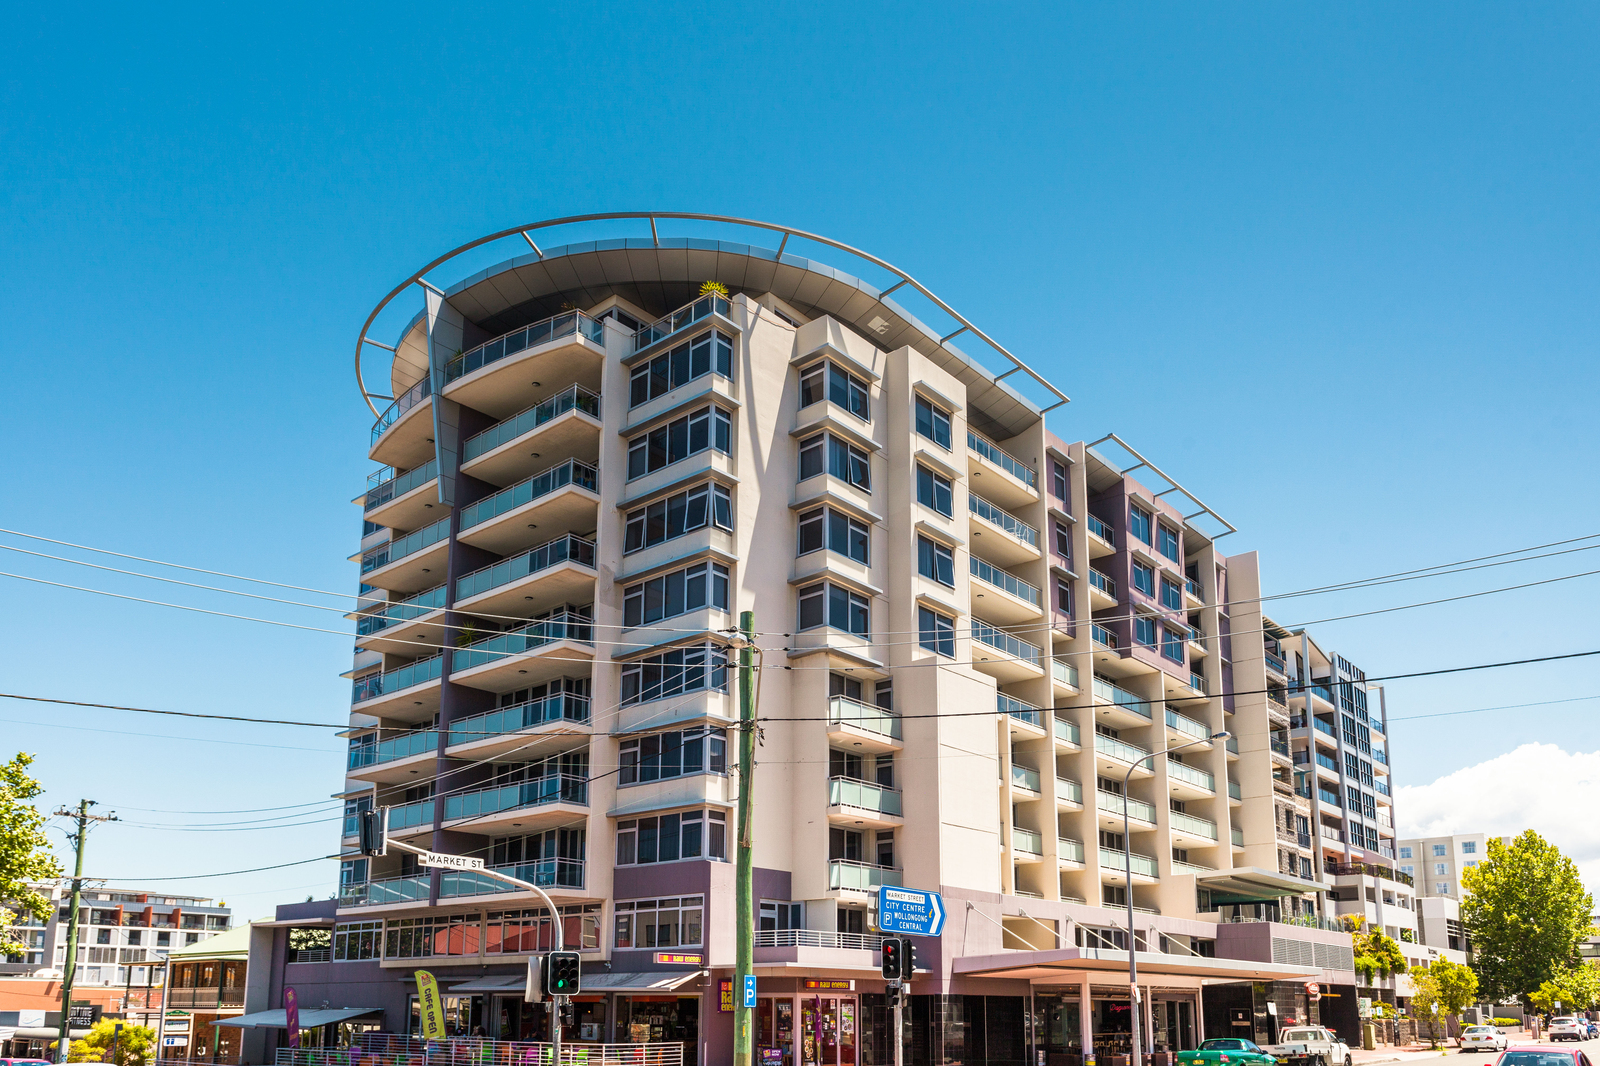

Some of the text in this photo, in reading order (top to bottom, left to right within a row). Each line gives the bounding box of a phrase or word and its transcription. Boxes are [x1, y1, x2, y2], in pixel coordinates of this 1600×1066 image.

[428, 855, 482, 869] MARKET ST
[886, 891, 924, 903] MARKET STREET
[885, 901, 926, 914] CITY CENTRE
[893, 911, 928, 923] WOLLONGONG
[898, 921, 923, 931] CENTRAL
[424, 987, 434, 1010] CAFE
[721, 990, 733, 1004] Ra
[746, 988, 754, 1004] P
